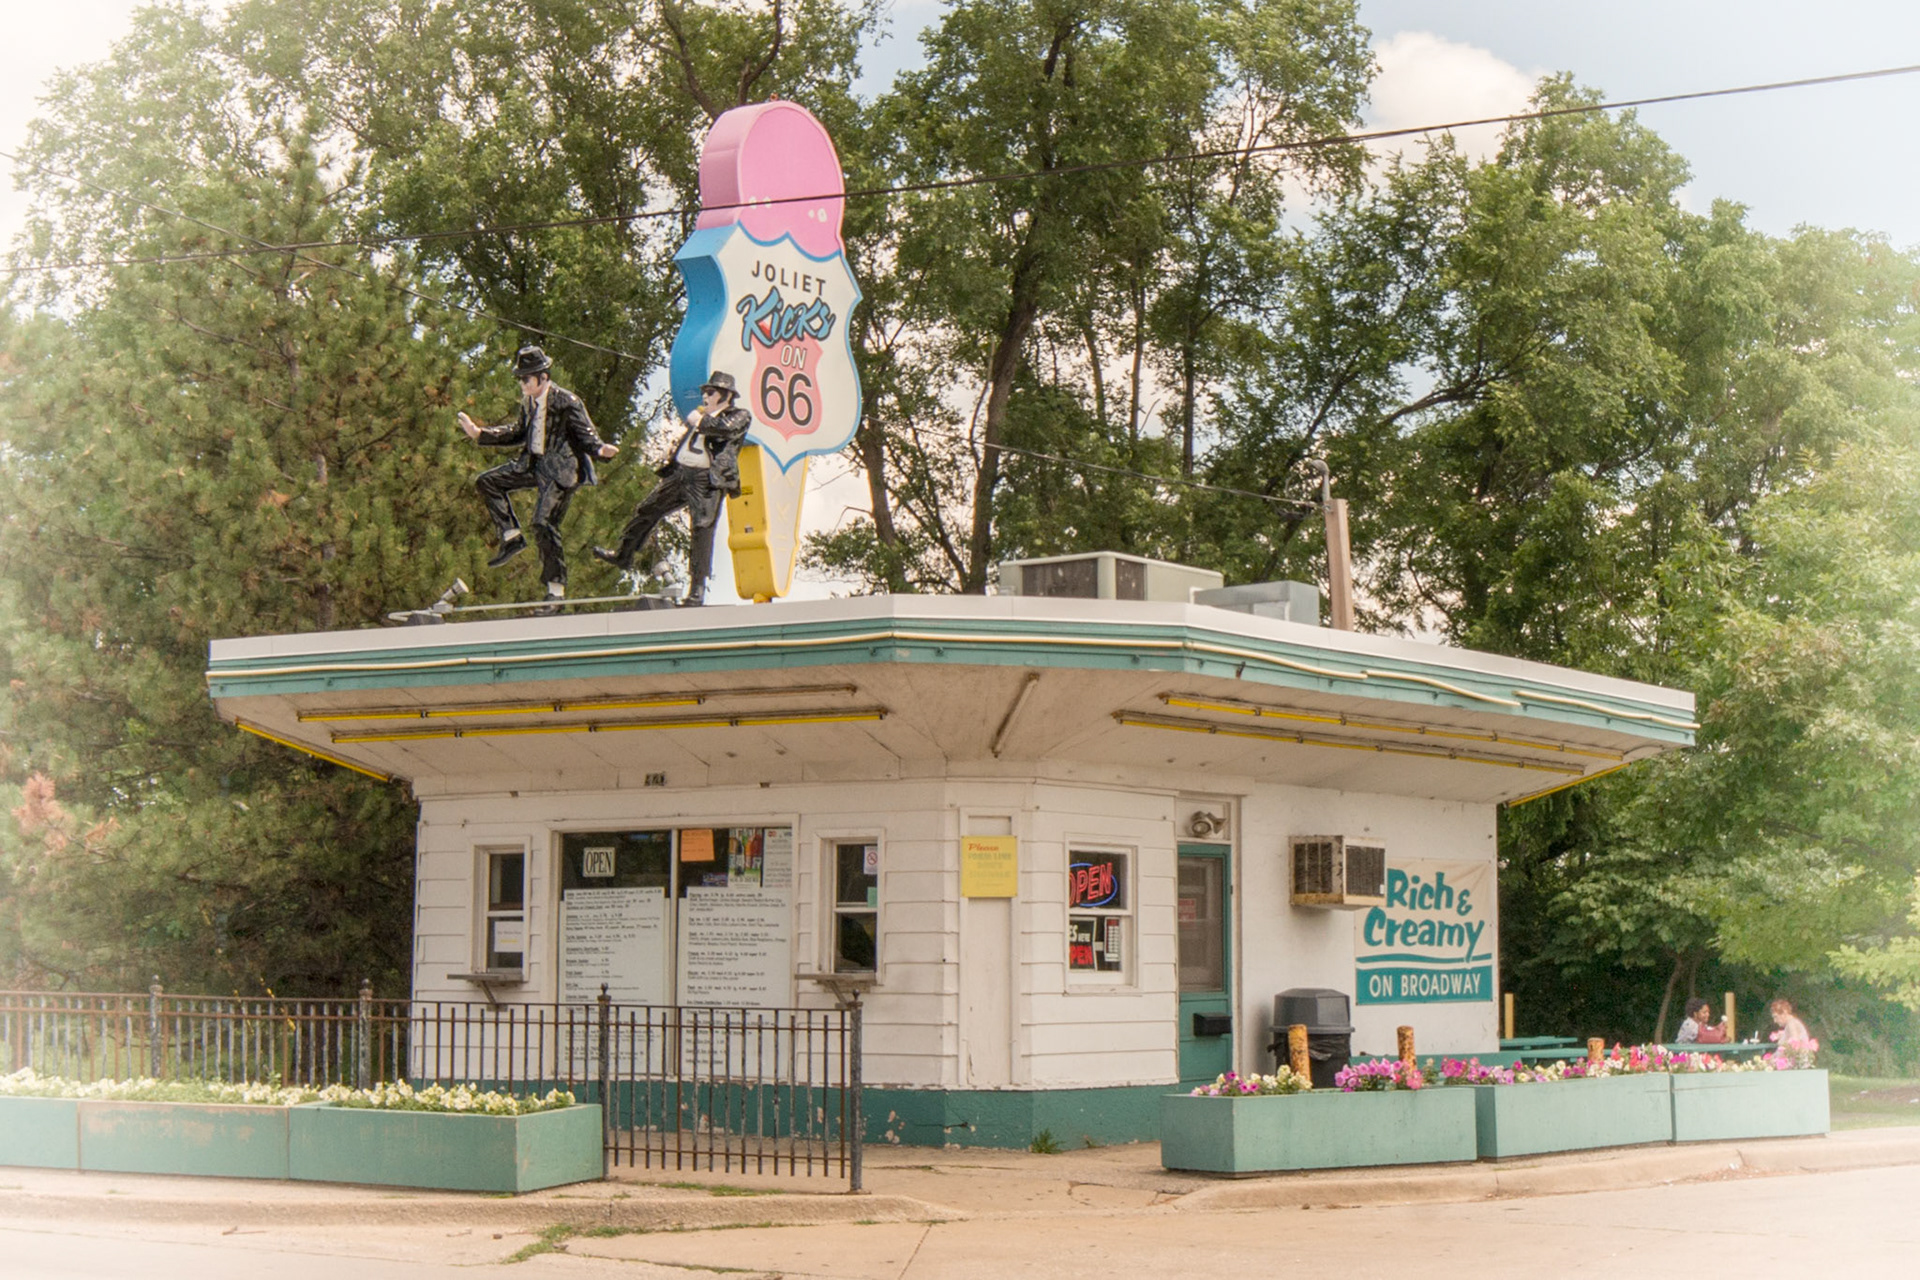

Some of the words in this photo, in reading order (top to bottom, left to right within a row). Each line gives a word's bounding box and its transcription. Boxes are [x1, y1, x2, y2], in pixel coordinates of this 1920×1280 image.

[751, 260, 826, 296] JOLIET
[780, 344, 808, 370] ON
[760, 366, 813, 427] 66
[967, 842, 999, 851] Please
[585, 851, 612, 874] OPEN
[1386, 868, 1454, 911] Rich
[1456, 888, 1473, 916] &
[1069, 924, 1079, 942] ES
[1363, 905, 1485, 963] Creamy
[1069, 944, 1093, 965] PEN
[1369, 974, 1393, 997] ON
[1401, 972, 1481, 997] BROADWAY
